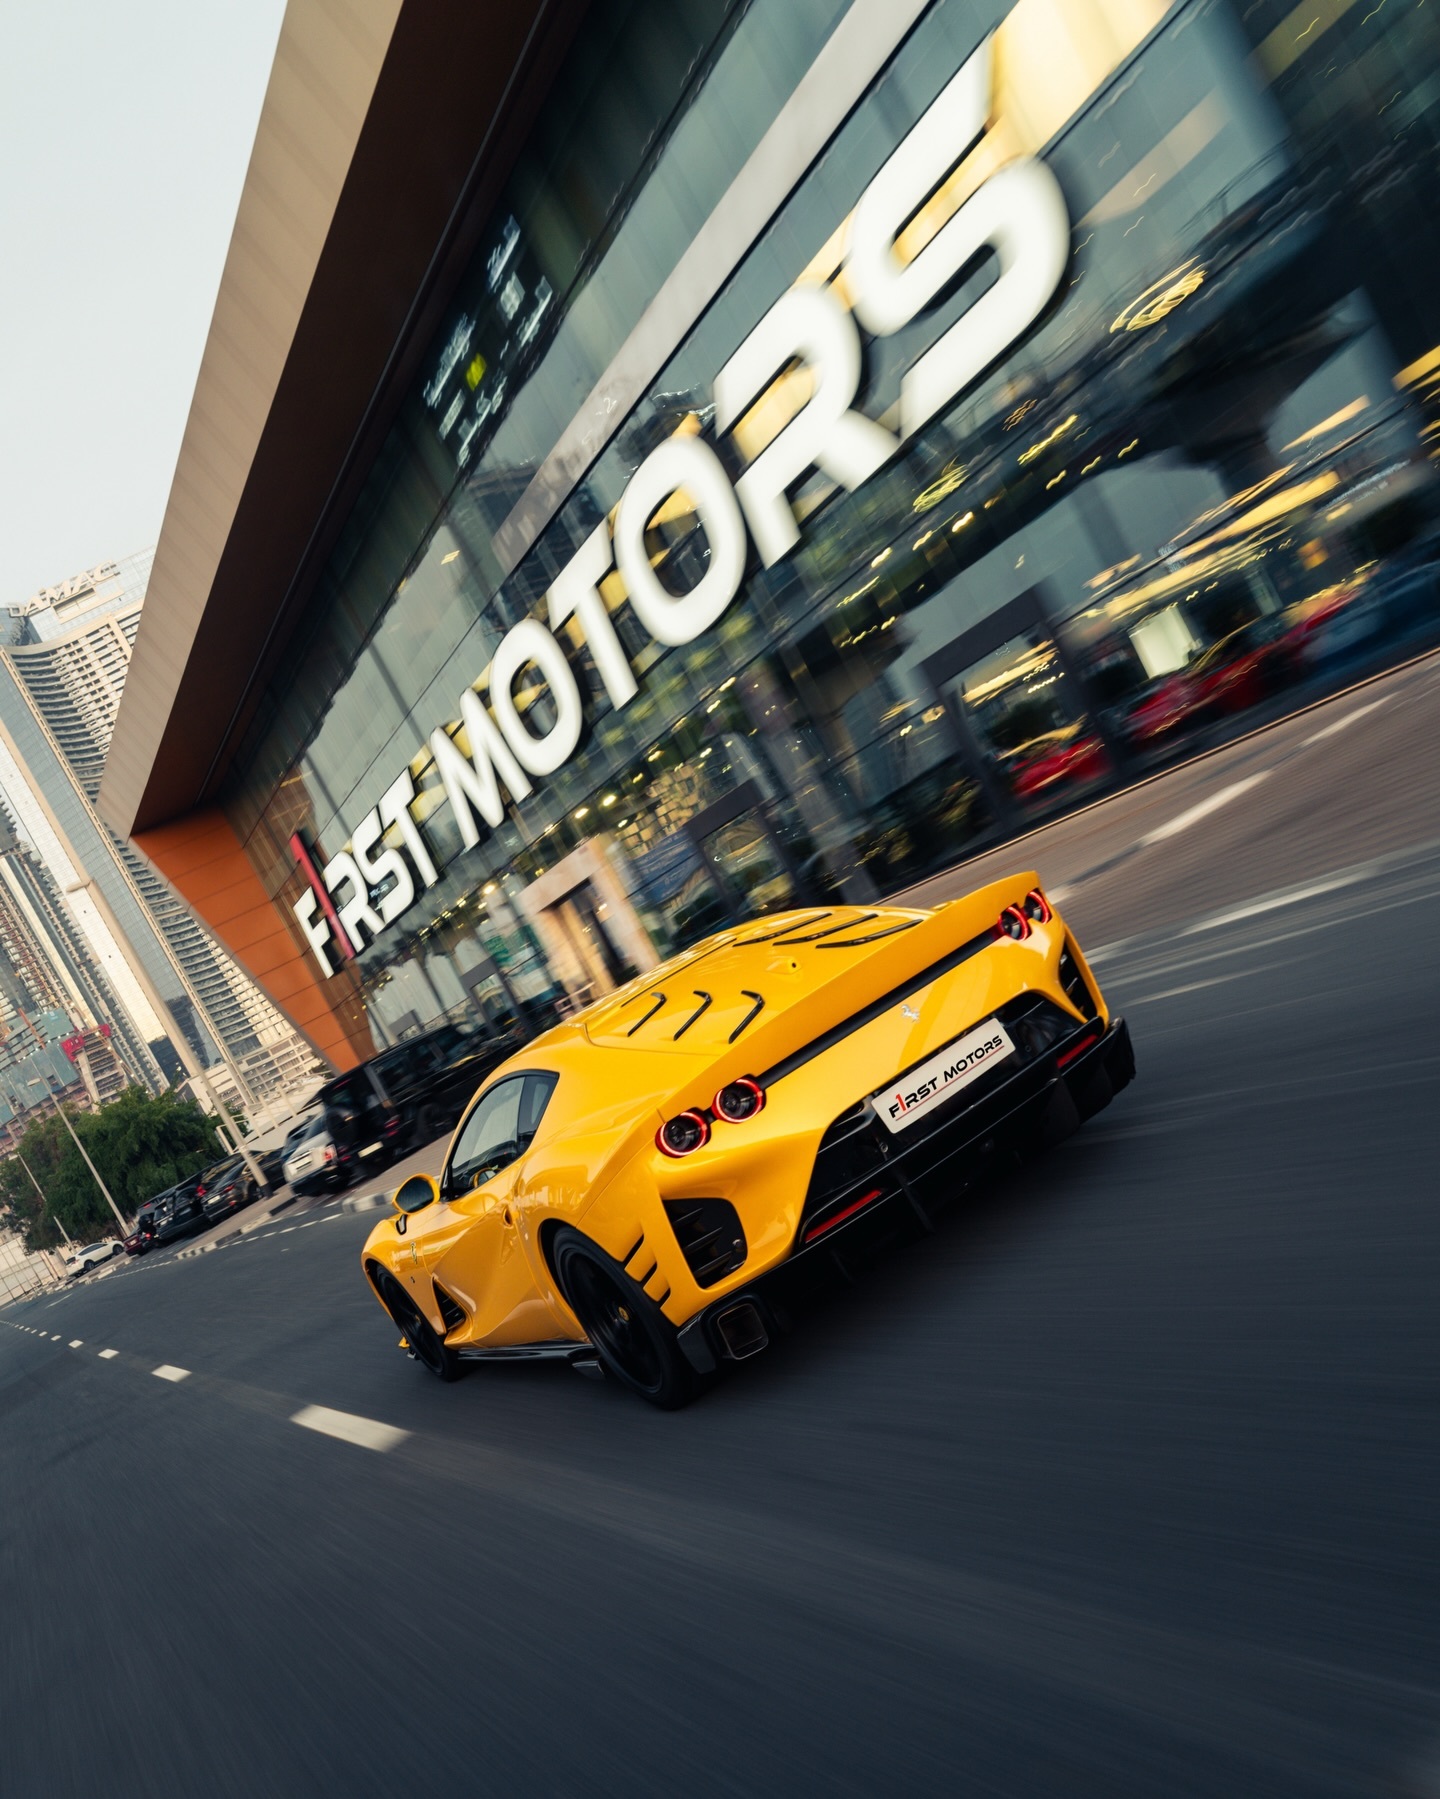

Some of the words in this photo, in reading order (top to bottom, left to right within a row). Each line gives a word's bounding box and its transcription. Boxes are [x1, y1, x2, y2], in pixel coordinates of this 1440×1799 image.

[430, 28, 1070, 850] MOTORS
[8, 560, 118, 617] DAMAC
[943, 1035, 1003, 1083] MOTORS
